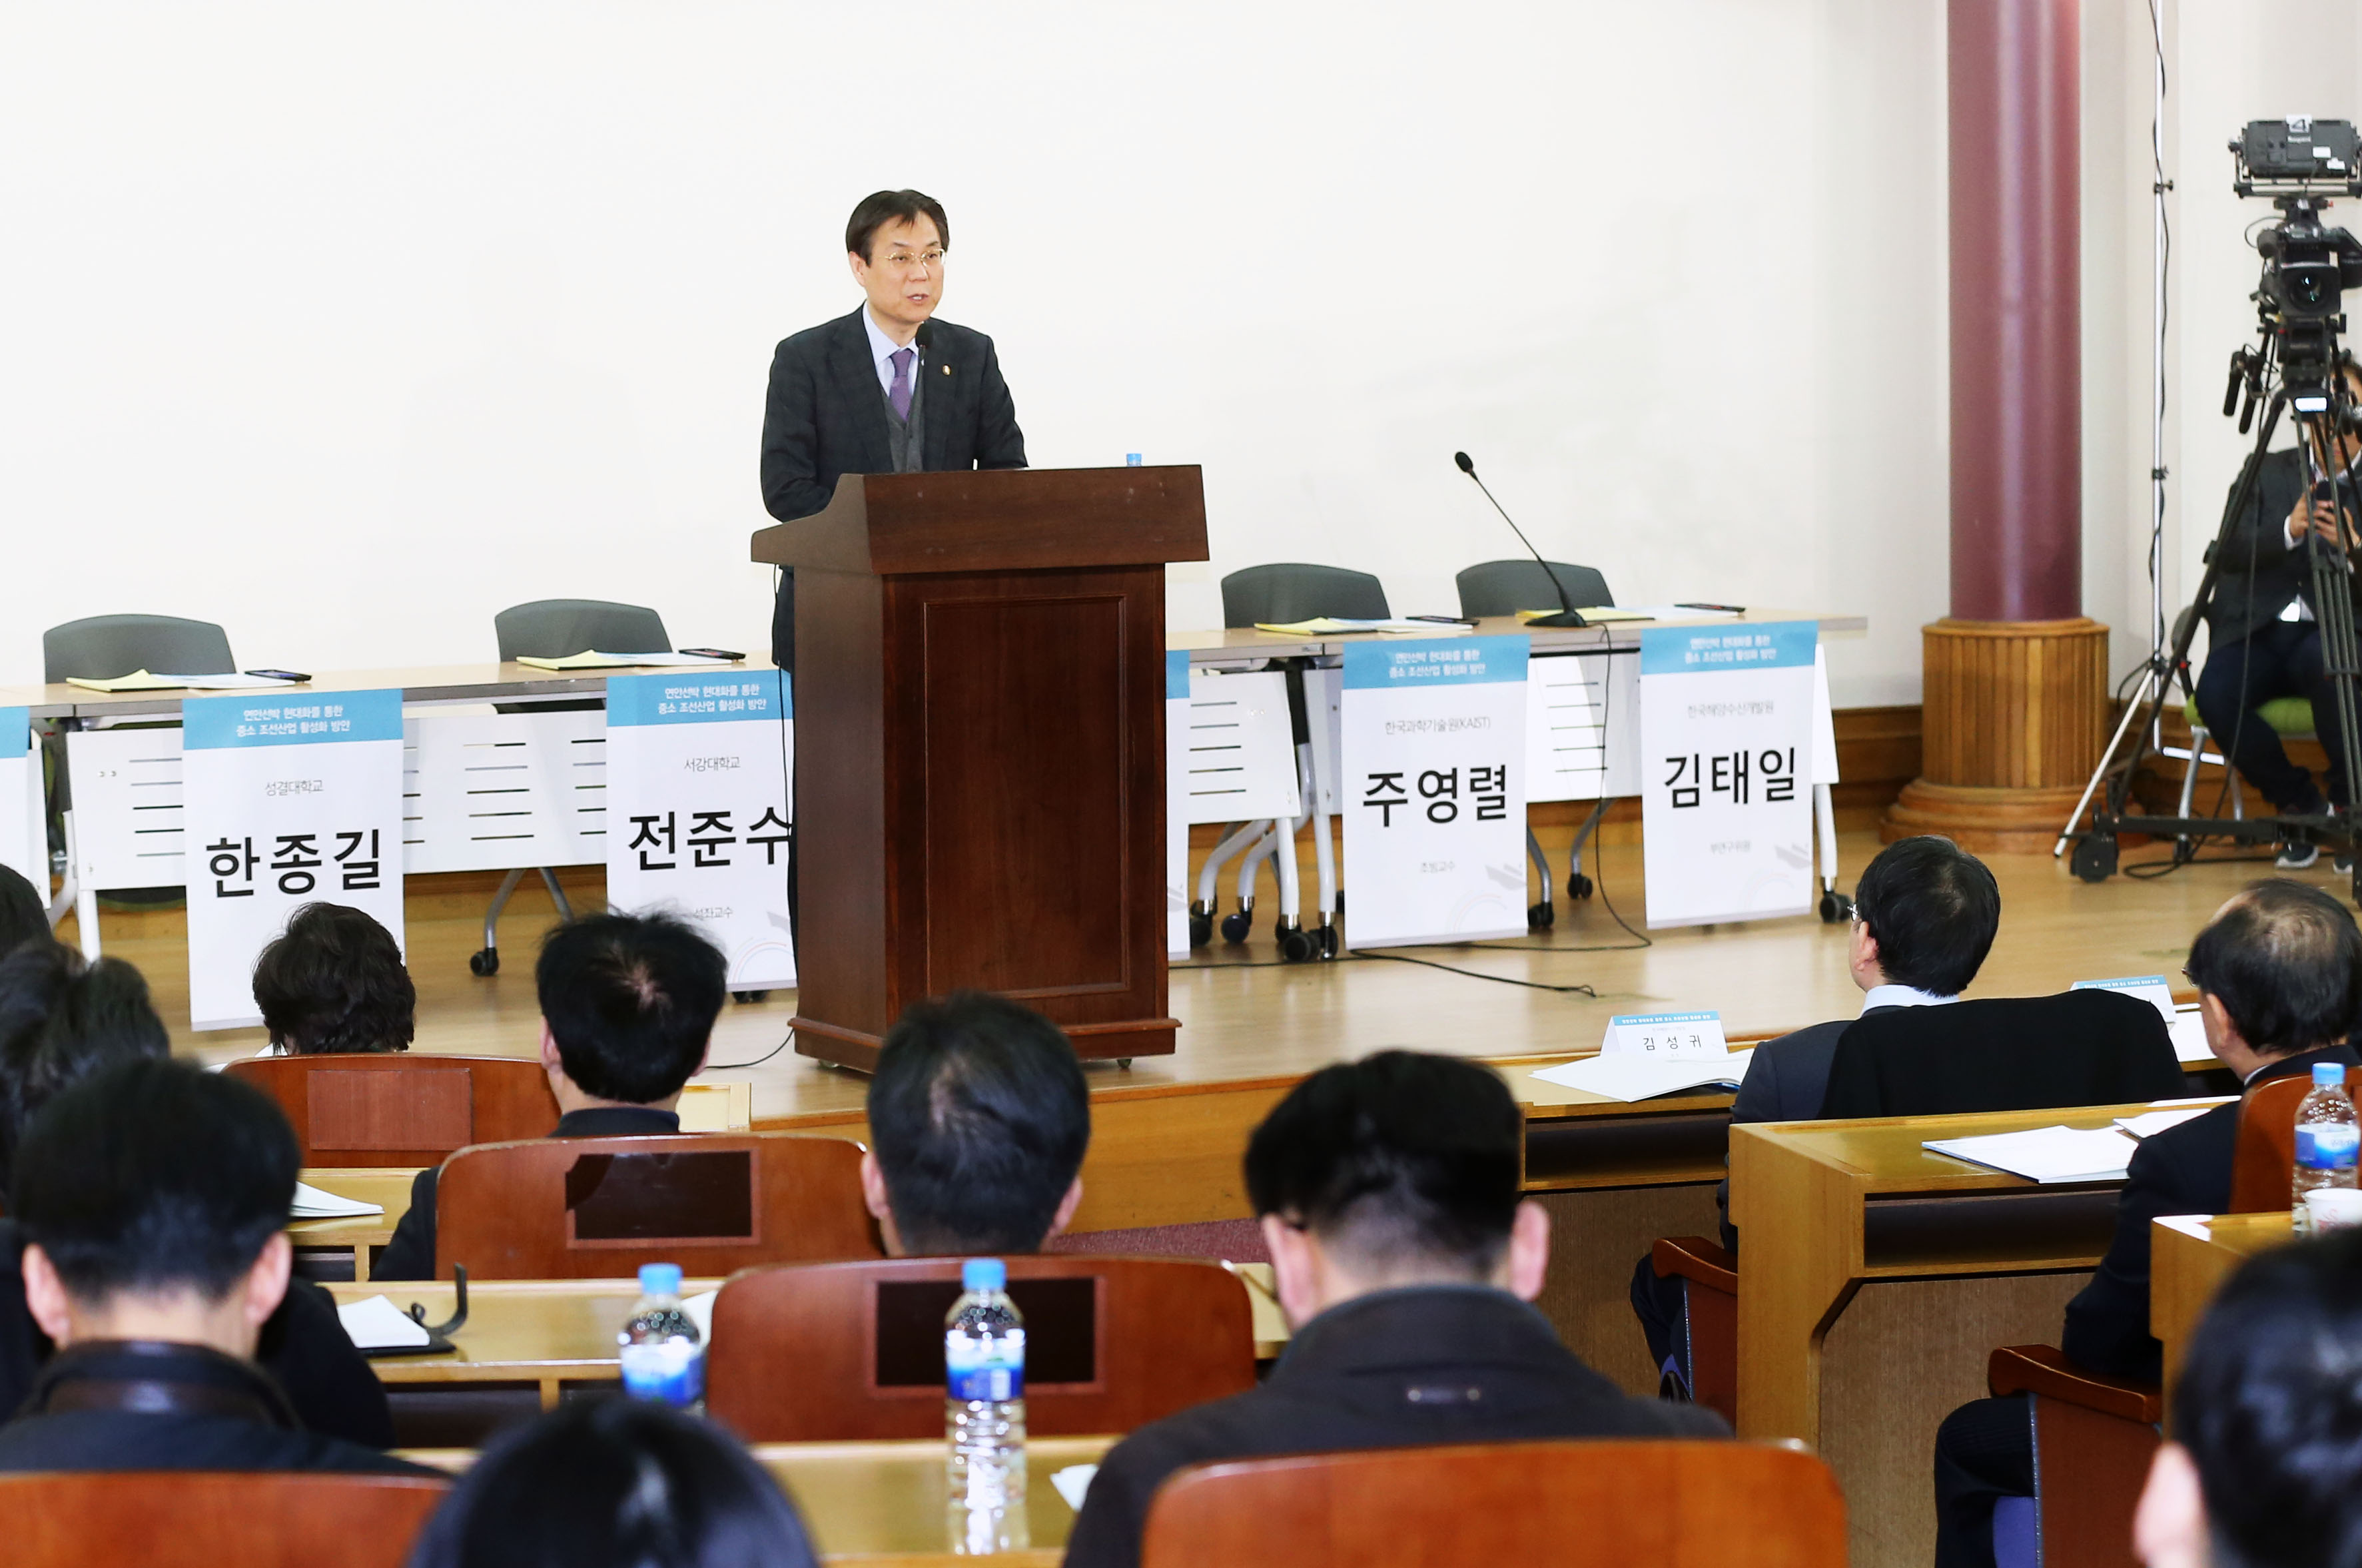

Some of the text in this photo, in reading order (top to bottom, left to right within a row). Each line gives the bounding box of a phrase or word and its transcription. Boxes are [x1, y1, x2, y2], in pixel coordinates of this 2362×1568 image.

[741, 683, 759, 696] 통한
[679, 700, 715, 713] 조선산업
[747, 698, 767, 711] 방안
[259, 722, 297, 735] 조선산업
[684, 756, 741, 773] 서강대학교
[1664, 747, 1795, 809] 김태일
[265, 779, 324, 797] 성결대학교
[1362, 764, 1507, 828] 주영렬
[628, 806, 792, 871] 전준수
[205, 829, 381, 898] 한종길
